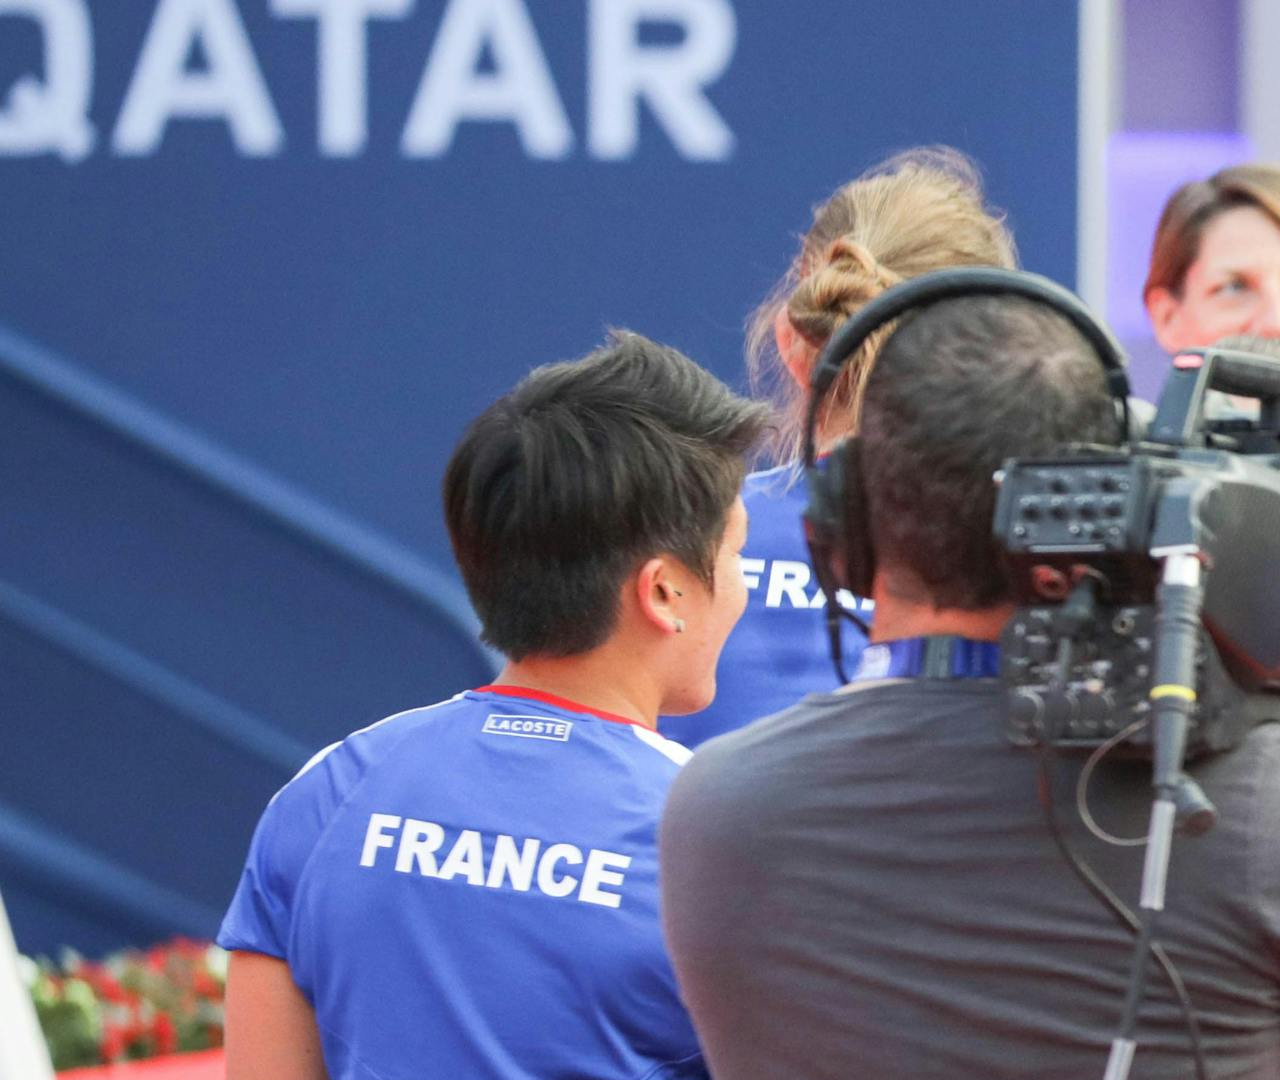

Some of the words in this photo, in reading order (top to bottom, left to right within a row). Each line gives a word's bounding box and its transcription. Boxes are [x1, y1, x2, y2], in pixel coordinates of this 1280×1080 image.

[0, 0, 737, 162] QATAR
[487, 718, 566, 736] LACOSTE
[359, 812, 633, 909] FRANCE
